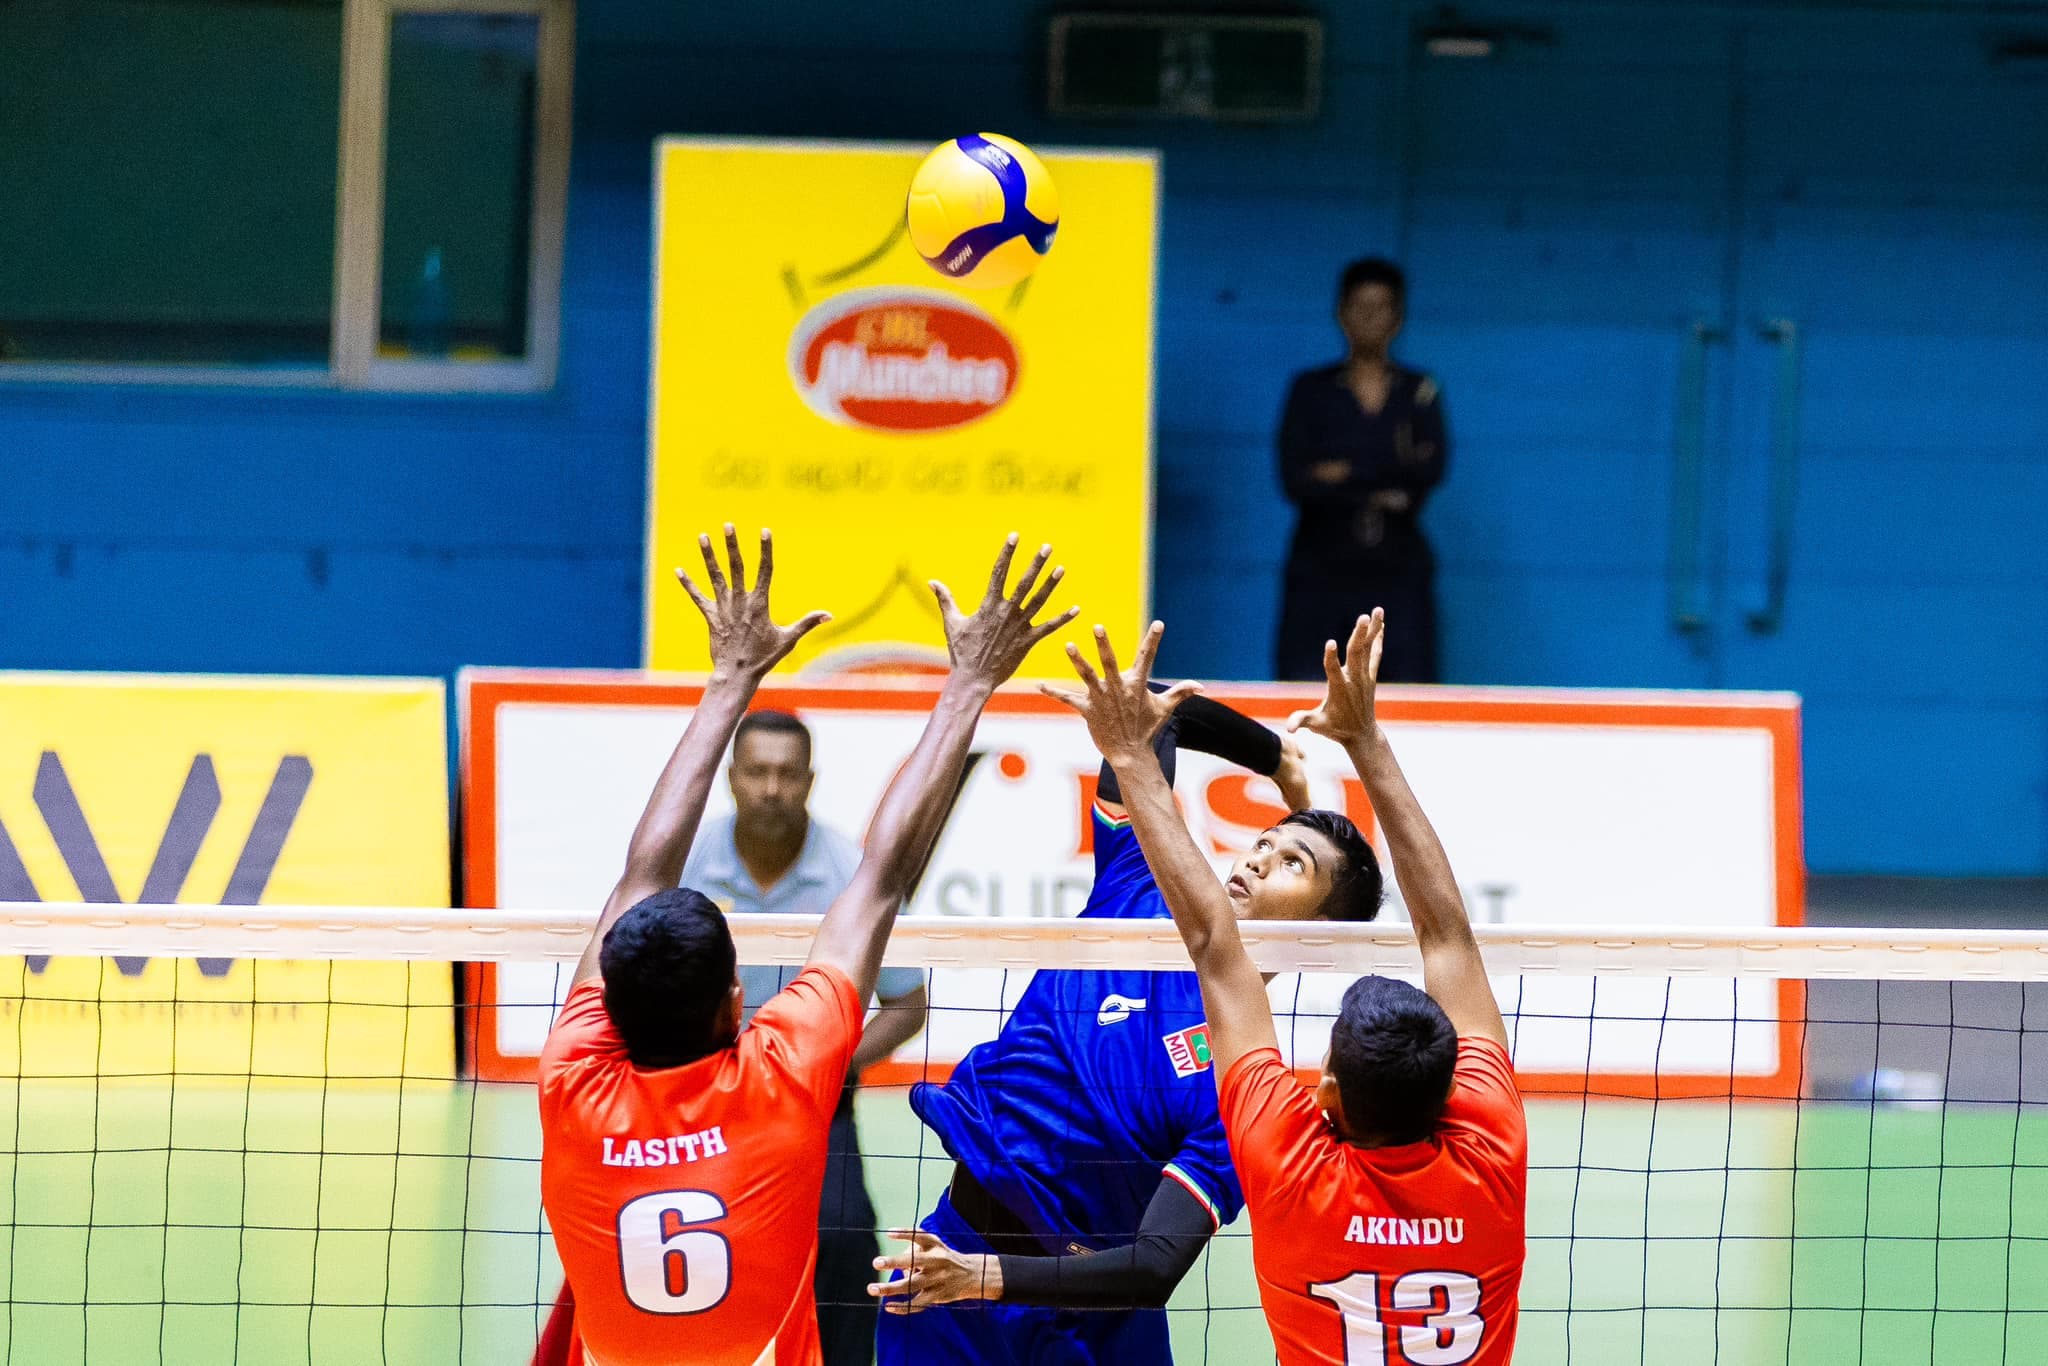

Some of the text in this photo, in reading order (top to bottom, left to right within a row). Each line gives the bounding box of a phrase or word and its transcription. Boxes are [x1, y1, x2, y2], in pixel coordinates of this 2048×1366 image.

[1165, 1034, 1194, 1072] MDV
[602, 1126, 728, 1167] LASITH
[1344, 1215, 1465, 1245] AKINDU
[617, 1188, 732, 1316] 6
[1307, 1268, 1486, 1366] 13
